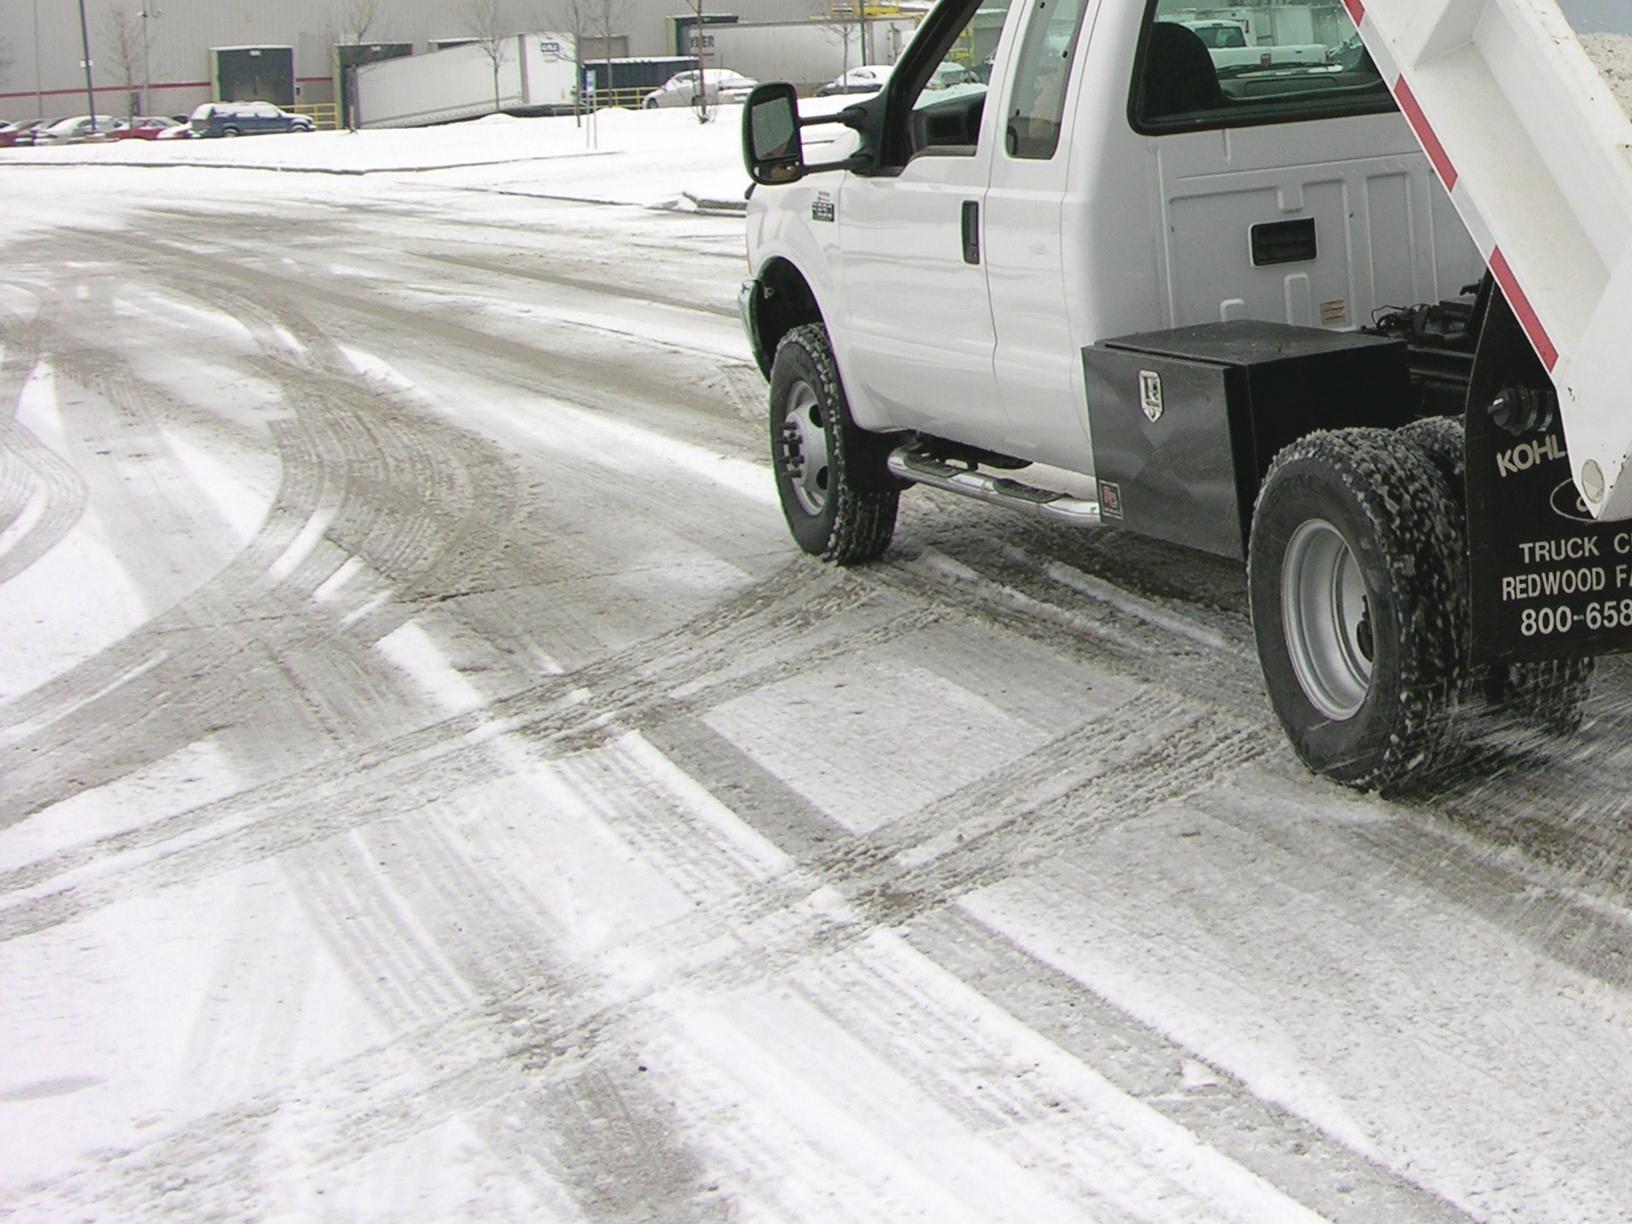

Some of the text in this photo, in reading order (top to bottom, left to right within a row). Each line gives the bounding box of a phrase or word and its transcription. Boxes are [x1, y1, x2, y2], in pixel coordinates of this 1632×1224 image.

[1496, 434, 1567, 478] KOHL
[1518, 535, 1600, 564] TRUCK
[1502, 569, 1606, 602] REDWOOD
